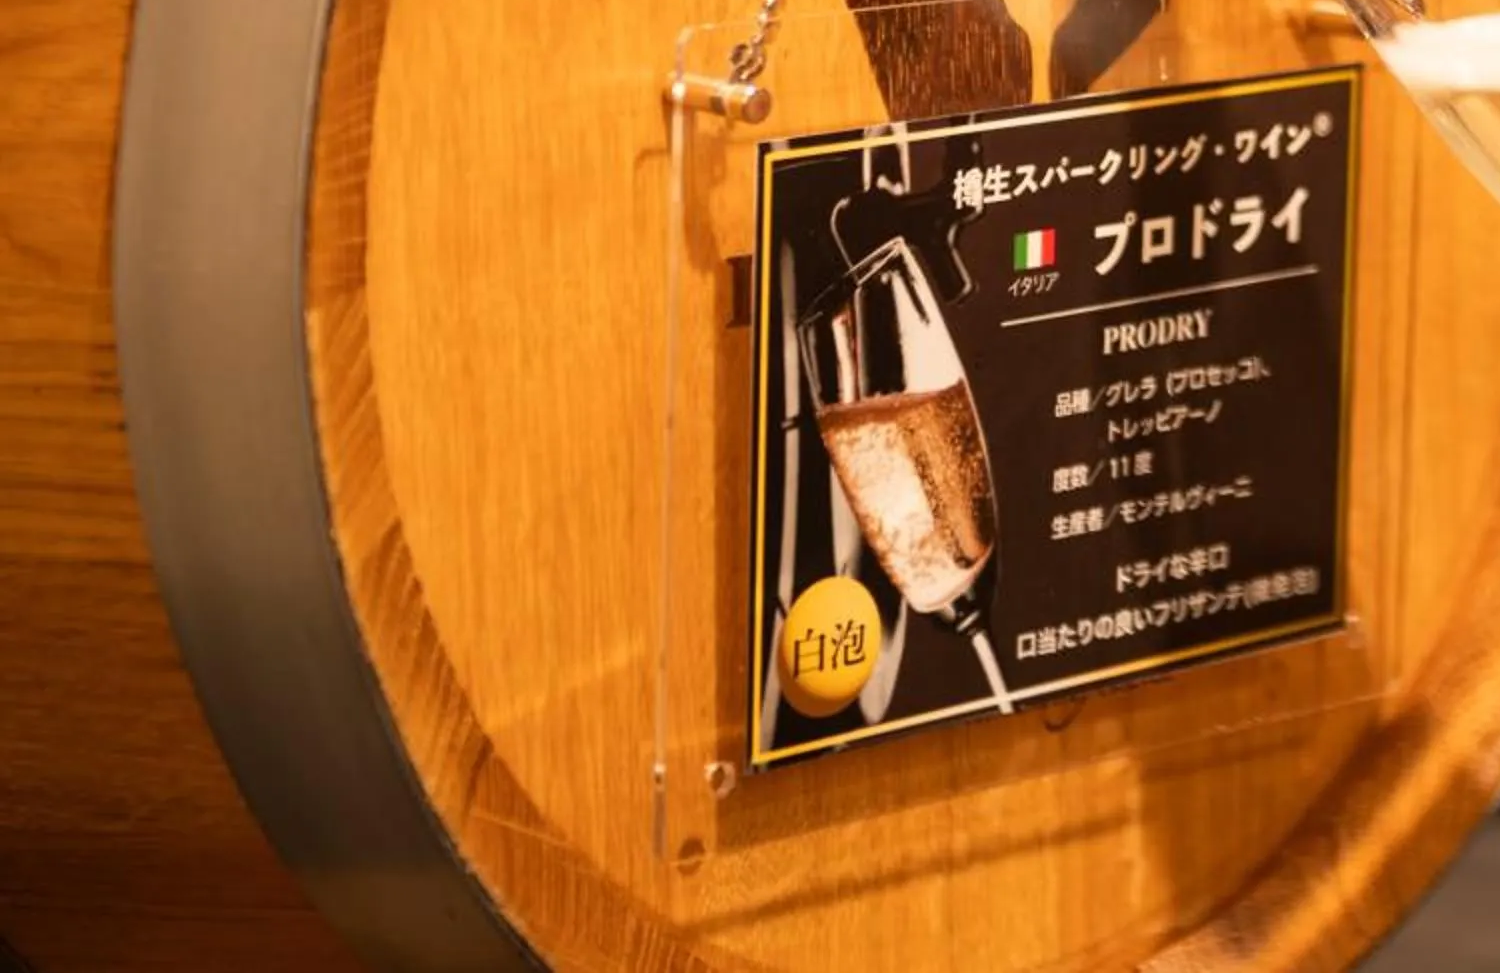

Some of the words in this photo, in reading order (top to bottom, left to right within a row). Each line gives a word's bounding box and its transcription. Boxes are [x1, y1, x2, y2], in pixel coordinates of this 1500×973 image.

[1095, 187, 1310, 275] プロドライ
[1008, 272, 1060, 297] イタリア
[1103, 309, 1213, 355] PRODRY
[1116, 543, 1230, 592] ドライな辛口
[793, 619, 866, 679] 白泡
